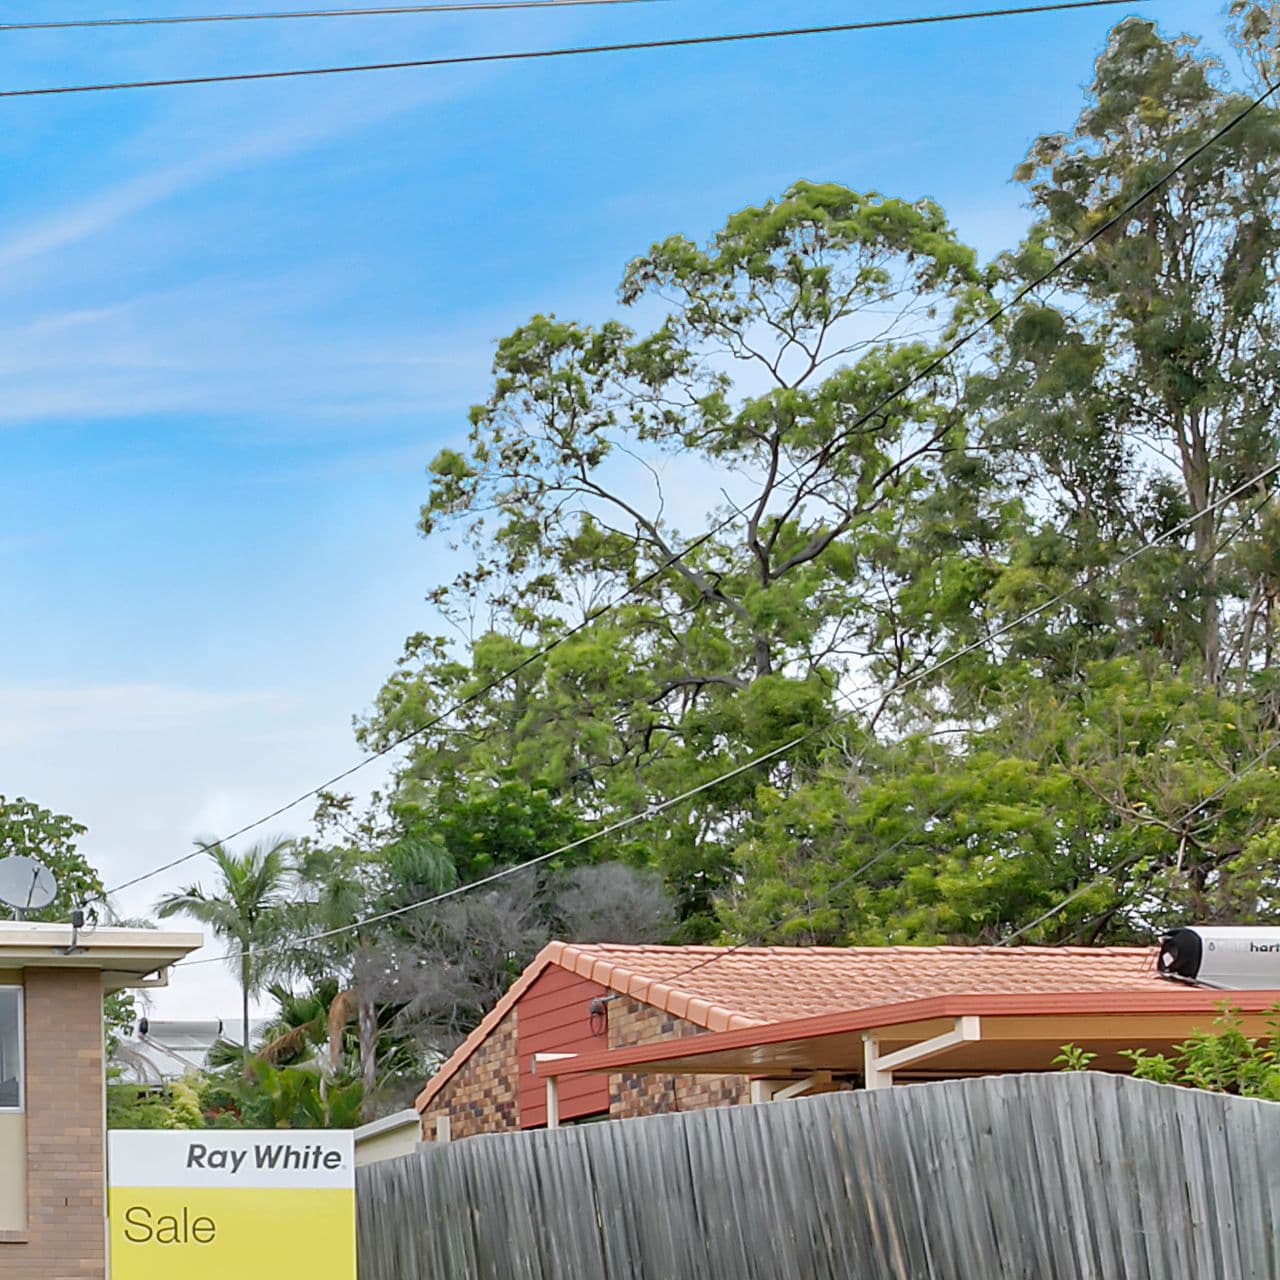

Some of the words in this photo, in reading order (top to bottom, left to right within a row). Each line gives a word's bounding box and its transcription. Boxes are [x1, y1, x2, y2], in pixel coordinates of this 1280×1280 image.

[186, 1143, 248, 1174] Ray
[254, 1144, 342, 1170] White
[123, 1206, 216, 1244] Sale
